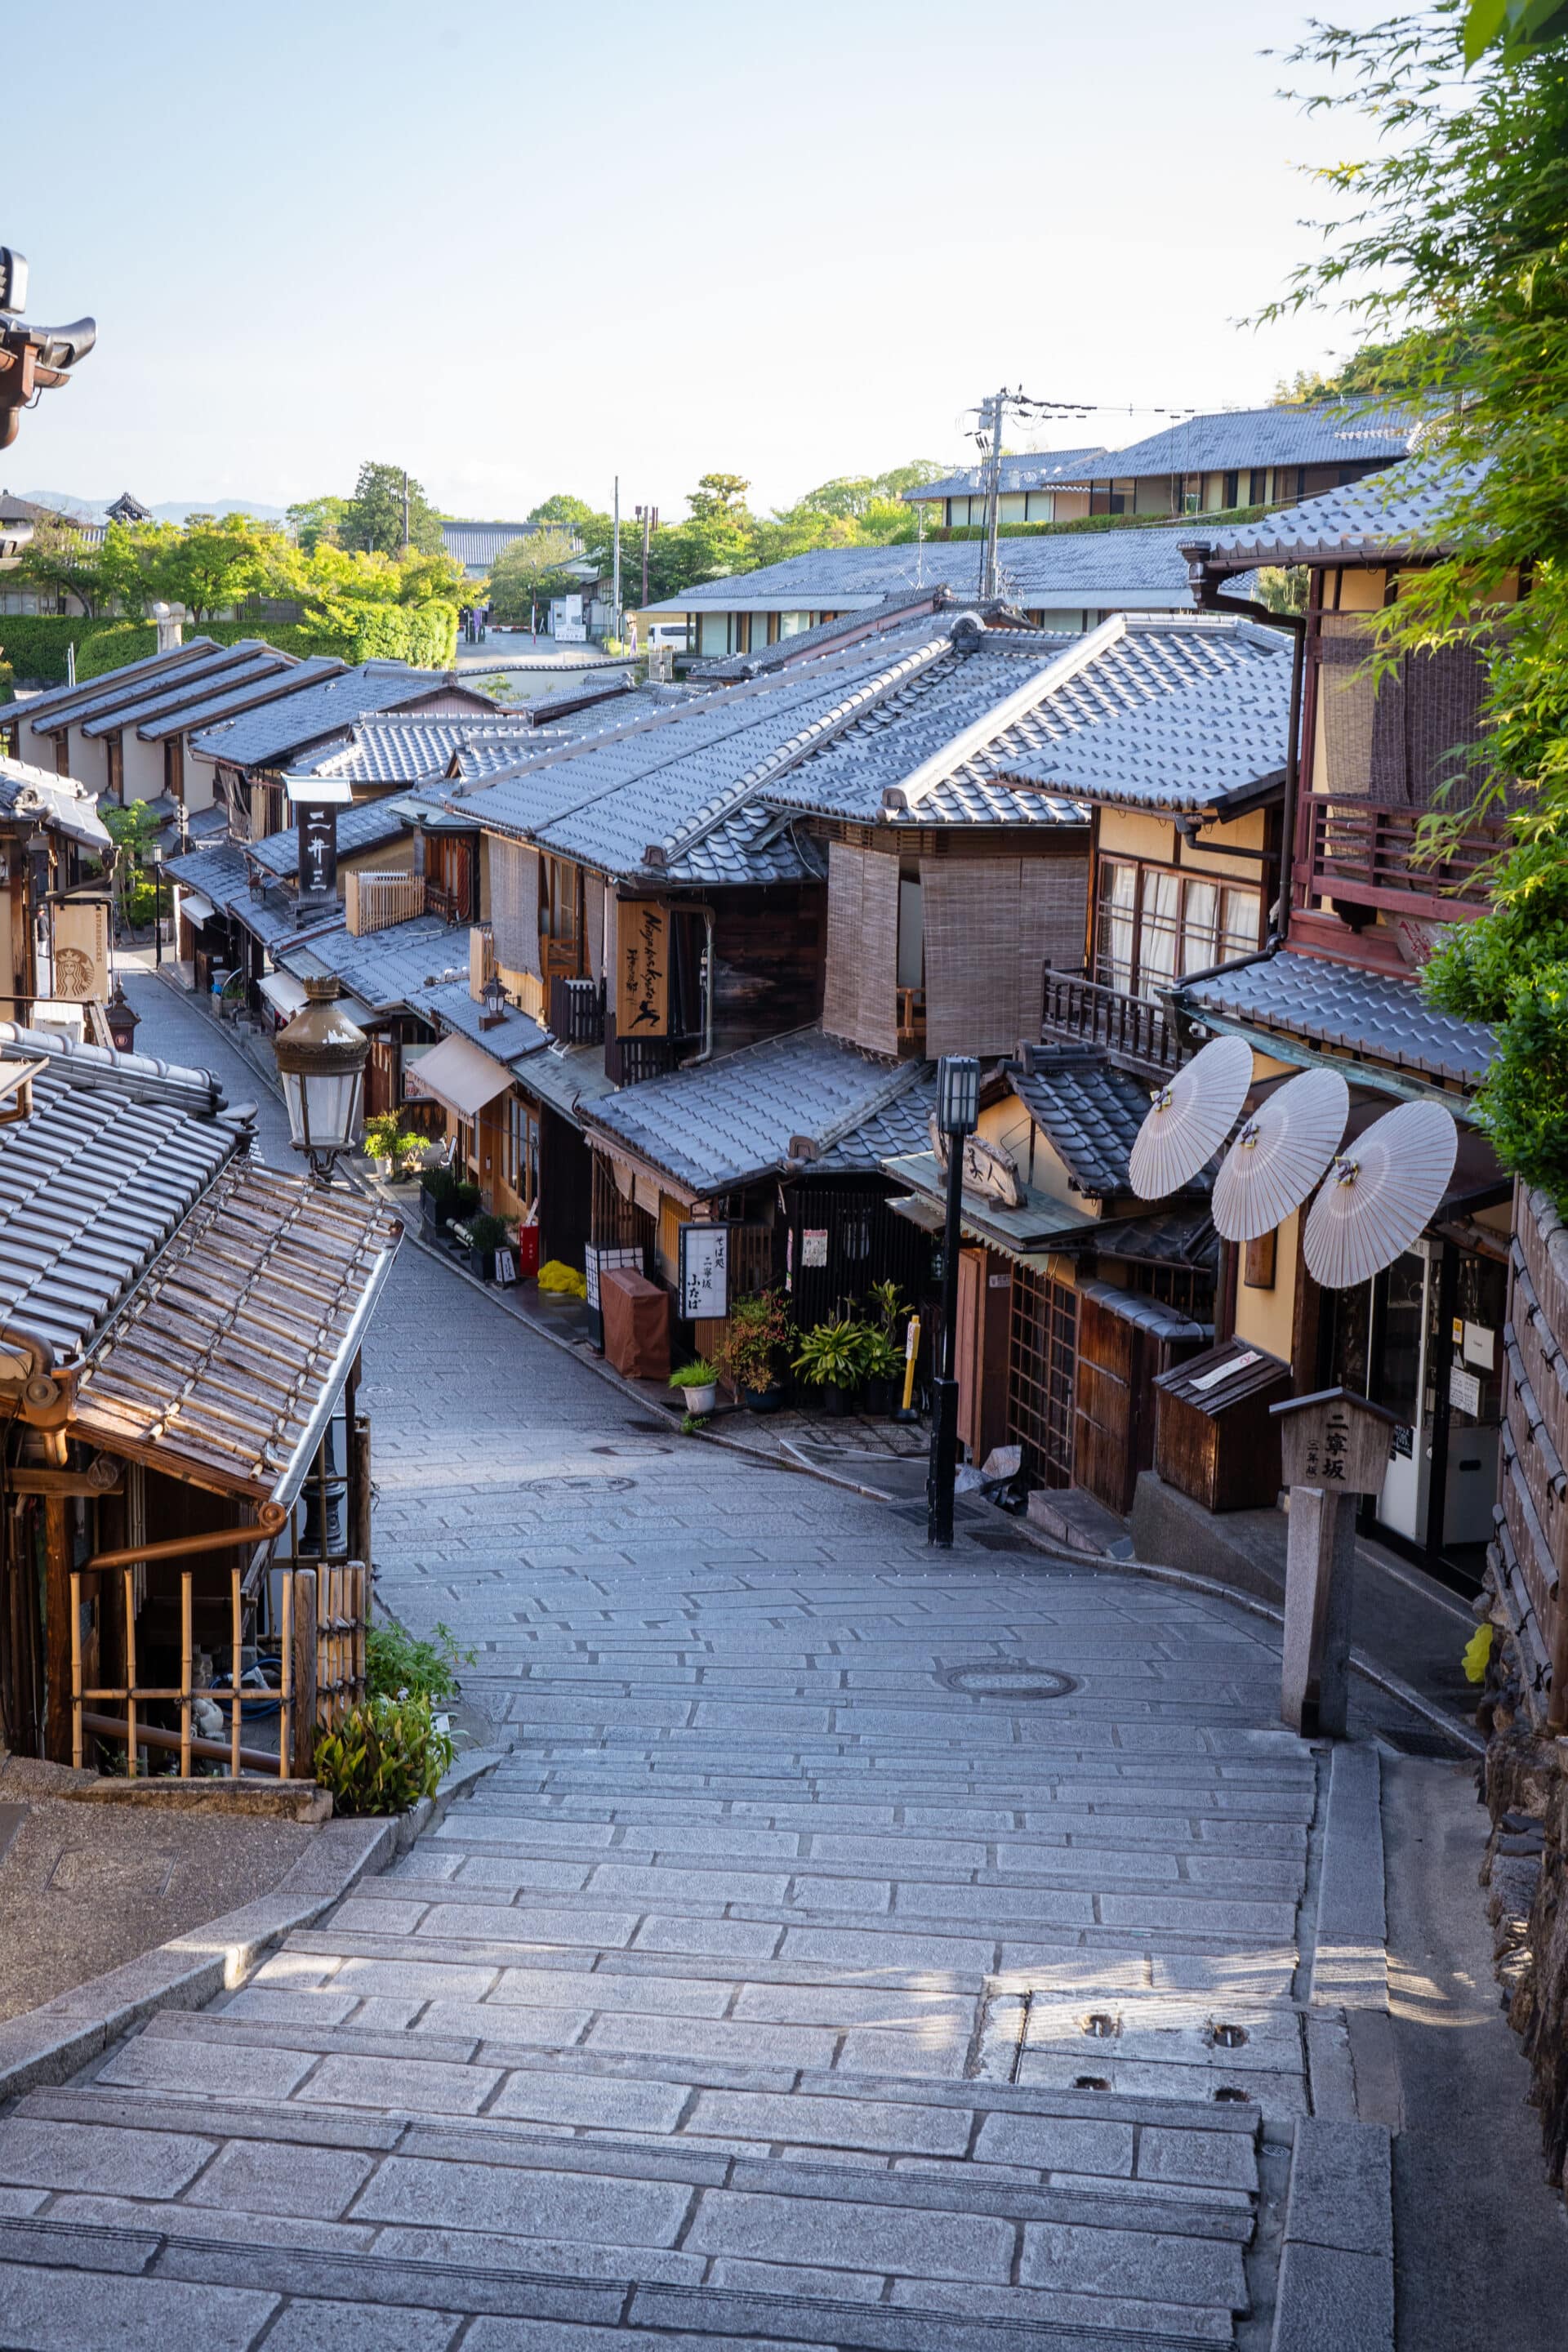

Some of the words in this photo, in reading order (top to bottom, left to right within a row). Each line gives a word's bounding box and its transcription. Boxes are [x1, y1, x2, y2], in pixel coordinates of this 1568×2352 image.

[715, 1236, 724, 1268] そば処
[688, 1274, 702, 1310] ふたば
[1322, 1414, 1348, 1481] 二寧坂
